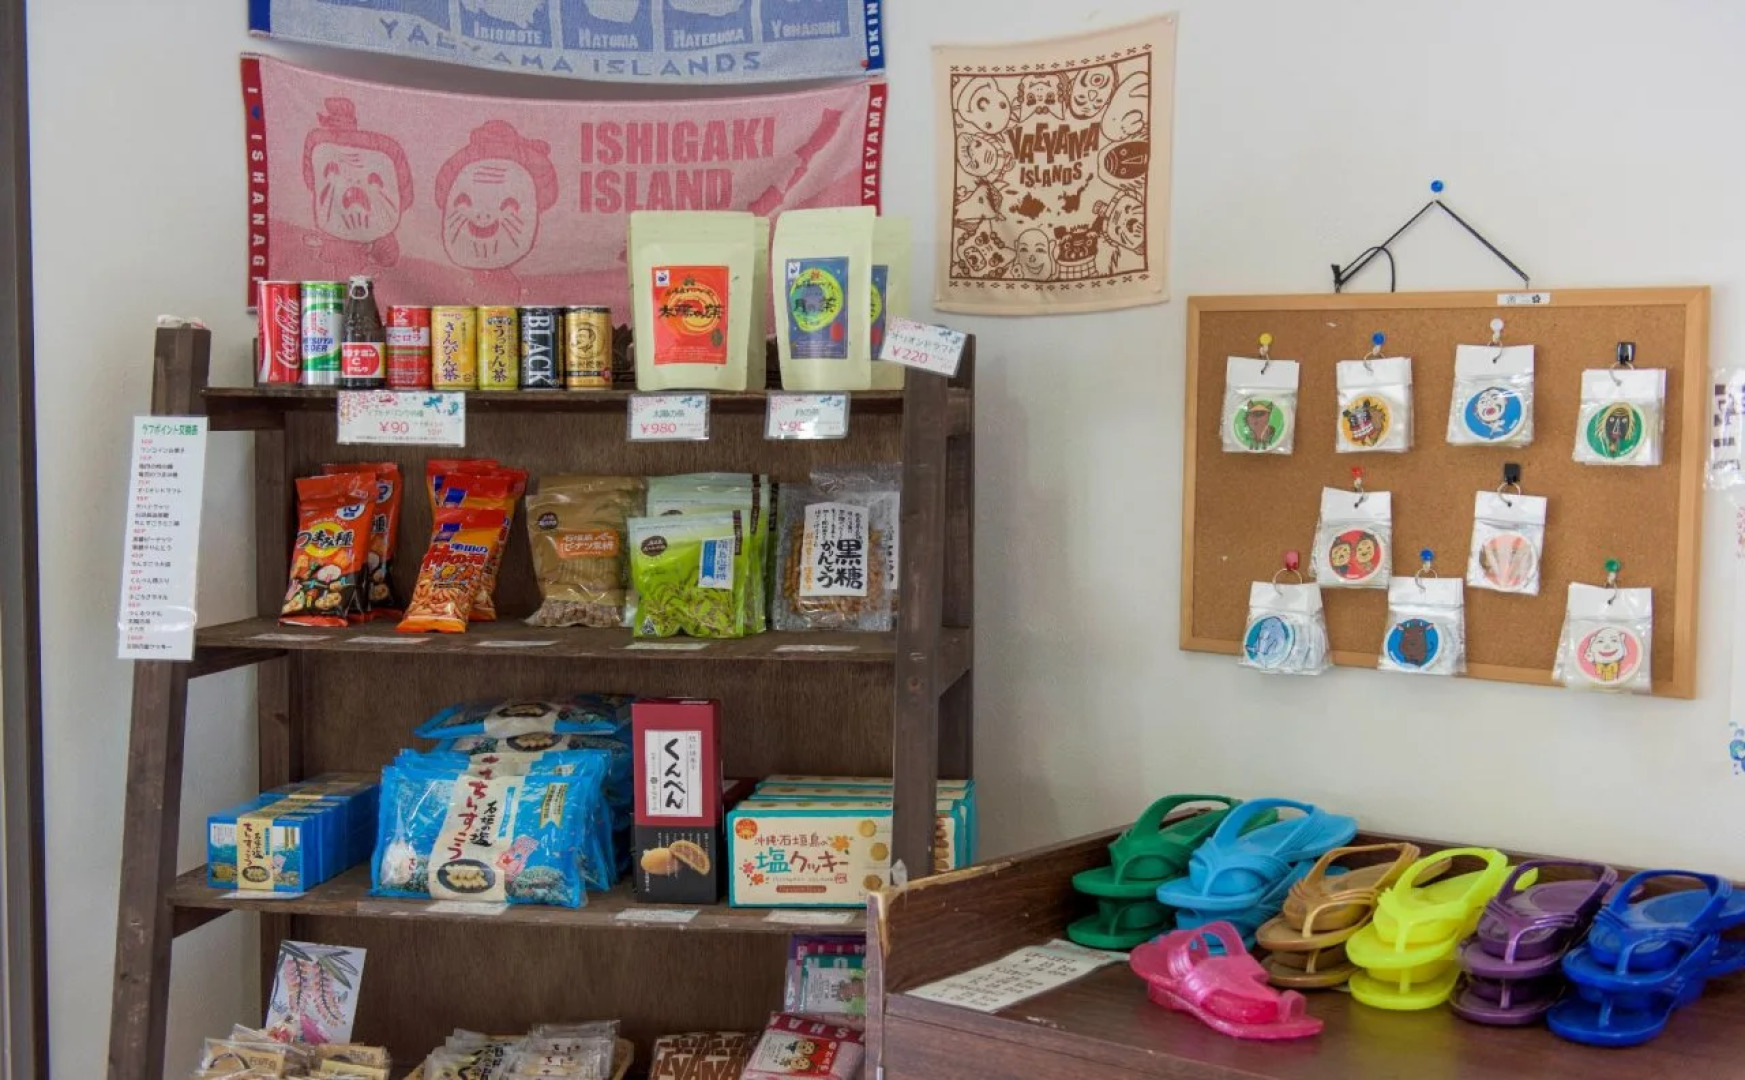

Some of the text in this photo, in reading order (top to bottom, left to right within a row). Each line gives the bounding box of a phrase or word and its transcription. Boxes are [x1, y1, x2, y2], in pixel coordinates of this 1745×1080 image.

[592, 51, 762, 76] ISLANDS
[580, 116, 776, 164] ISHIGAKI
[864, 95, 883, 200] YAEYAMA
[579, 168, 734, 214] ISLAND
[1019, 161, 1083, 188] ISLANDS
[275, 294, 300, 370] Coca-Cola
[528, 315, 552, 385] BLACK
[379, 421, 410, 434] ¥90
[639, 422, 677, 434] ¥980
[816, 540, 835, 589] かりんとう
[836, 538, 864, 590] 黒糖
[447, 780, 489, 860] ちんすこう
[754, 846, 849, 874] 塩クッキー
